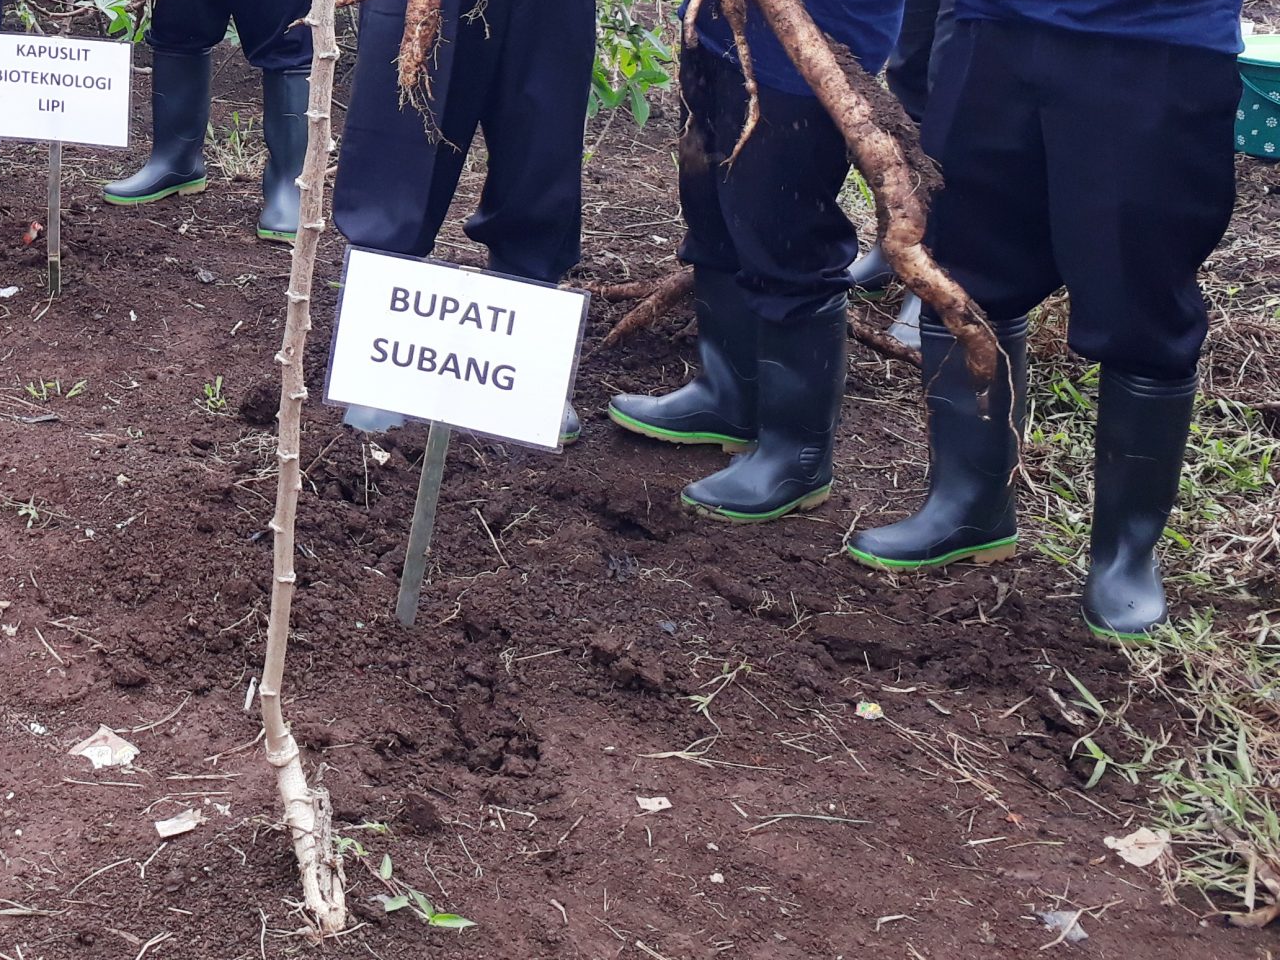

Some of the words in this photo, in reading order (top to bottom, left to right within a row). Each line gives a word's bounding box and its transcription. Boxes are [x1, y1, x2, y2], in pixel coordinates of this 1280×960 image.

[16, 43, 91, 62] KAPUSLIT
[38, 98, 65, 113] LIPI
[389, 286, 517, 336] BUPATI
[370, 337, 517, 391] SUBANG
